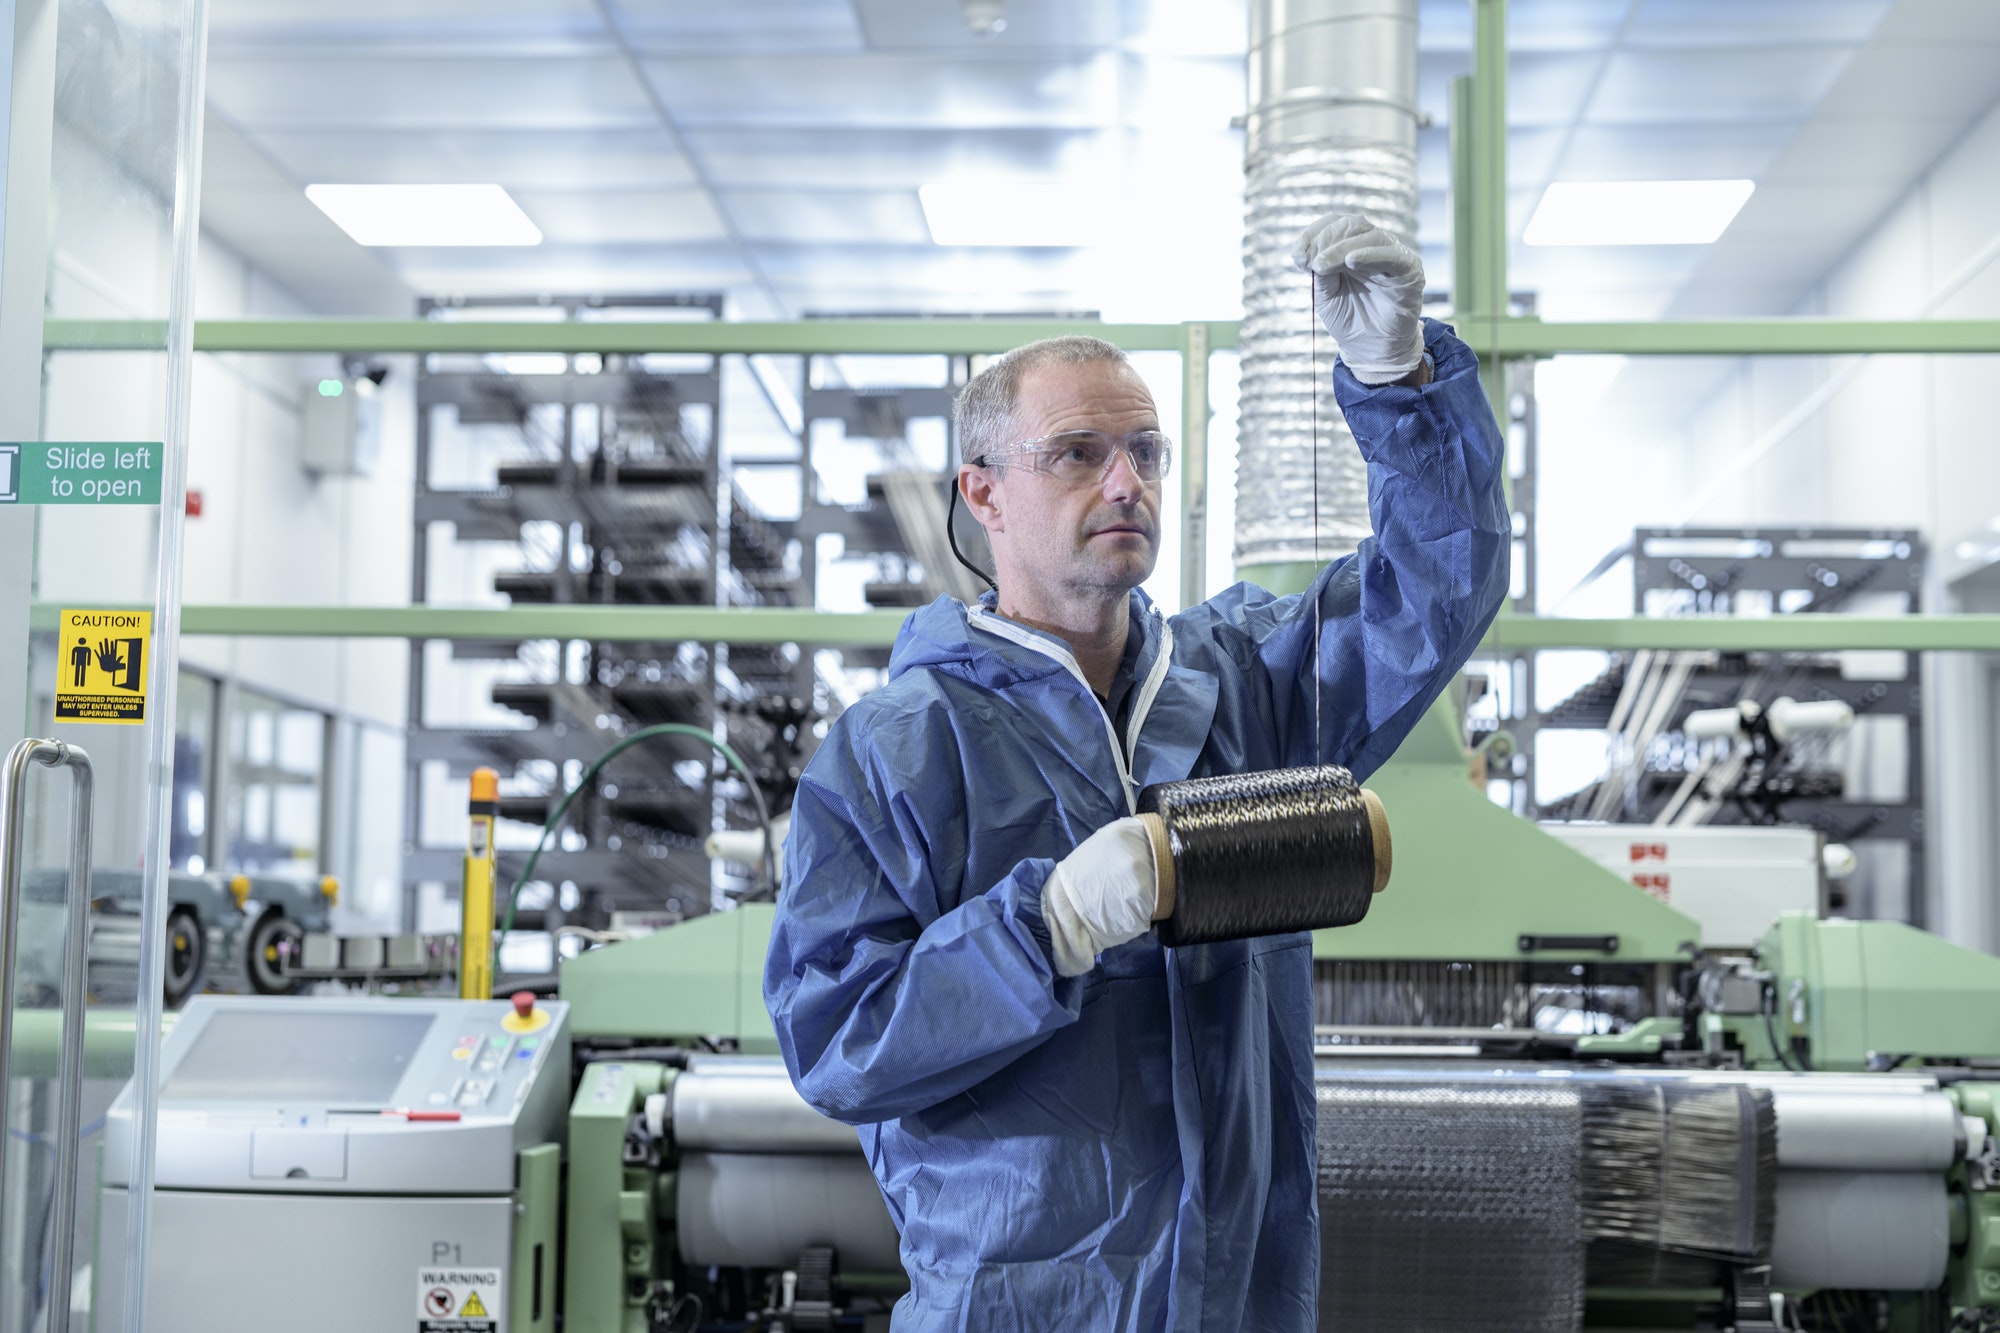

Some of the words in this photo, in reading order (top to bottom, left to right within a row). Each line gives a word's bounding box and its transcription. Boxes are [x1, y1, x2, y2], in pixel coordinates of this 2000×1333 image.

[46, 447, 105, 469] Slide
[114, 447, 151, 469] left
[51, 475, 73, 496] to
[81, 480, 141, 502] open
[71, 615, 140, 628] CAUTION!
[57, 695, 105, 703] UNAUTHORISED
[106, 696, 144, 704] PERSONNEL
[432, 1240, 462, 1264] P1
[421, 1272, 497, 1286] WARNING
